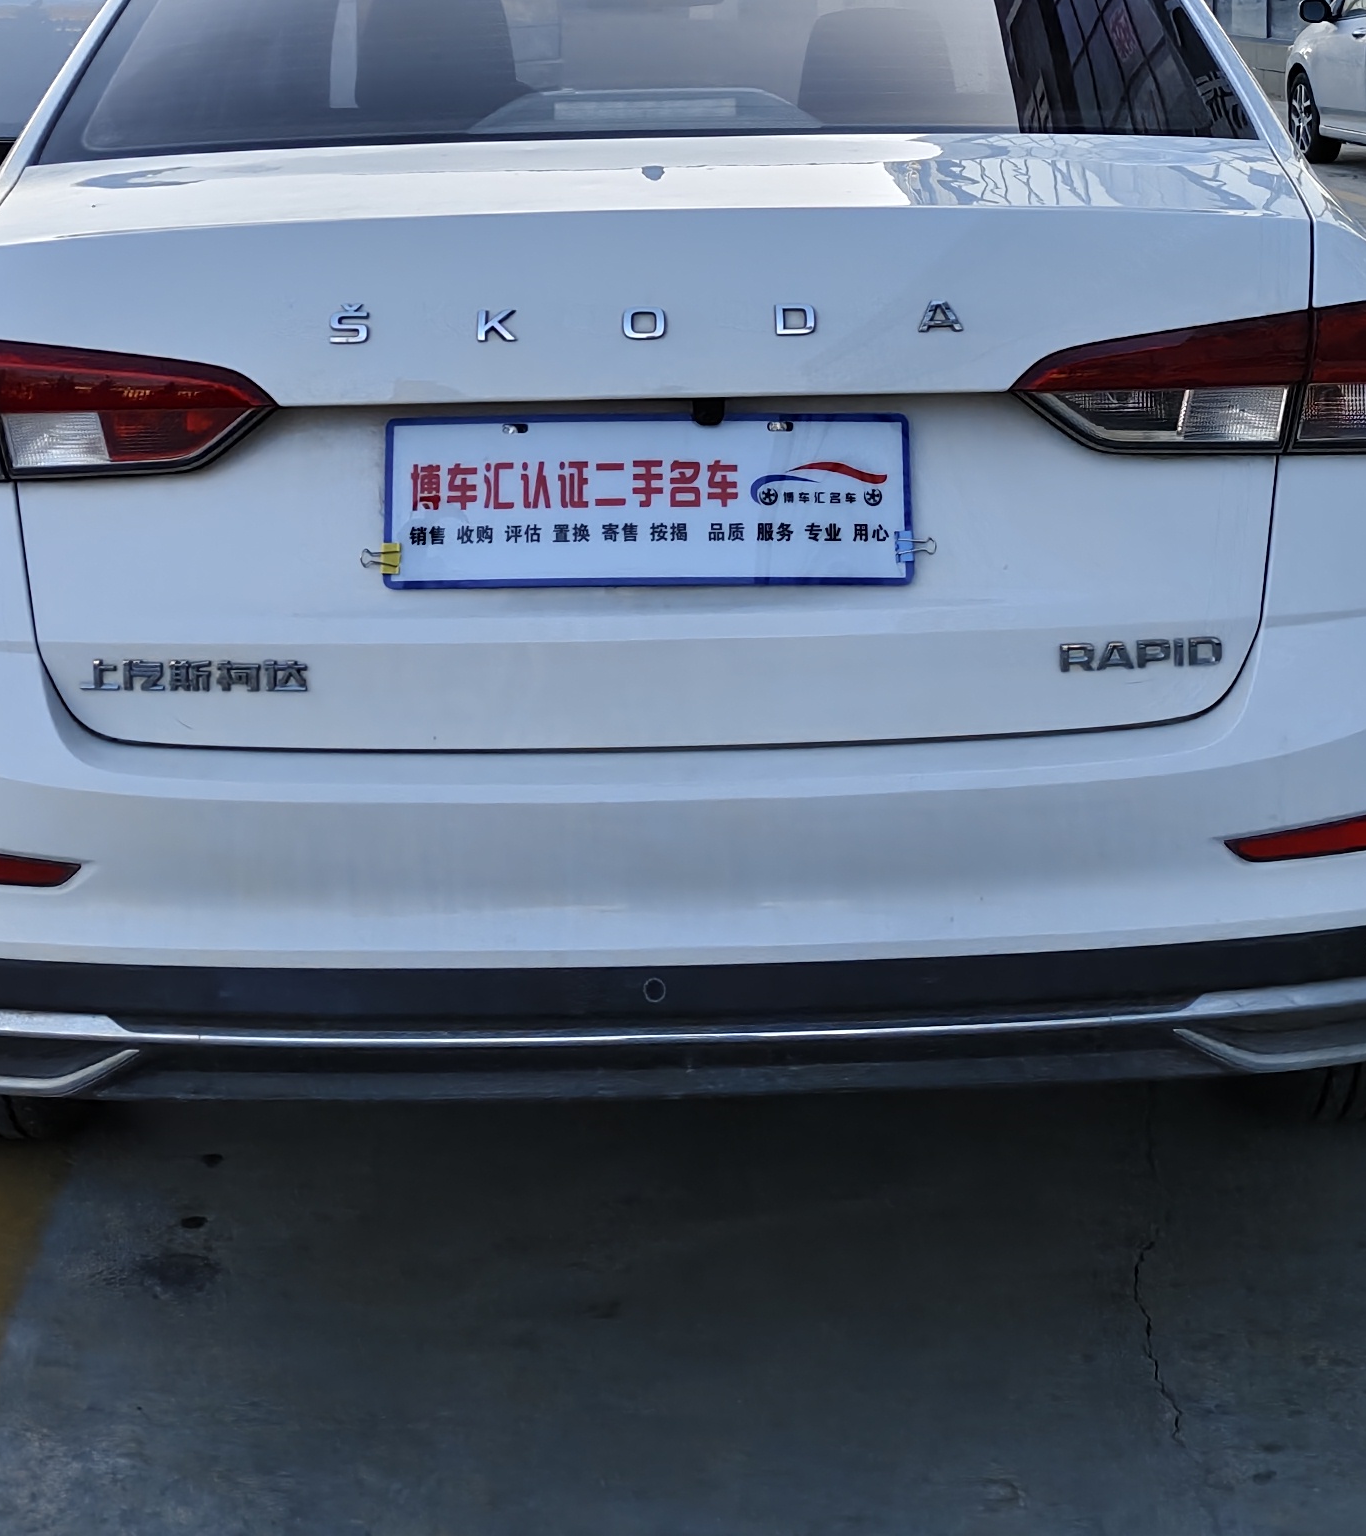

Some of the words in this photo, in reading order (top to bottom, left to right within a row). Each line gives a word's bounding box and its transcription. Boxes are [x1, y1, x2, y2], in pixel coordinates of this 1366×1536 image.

[328, 300, 965, 345] ŠKODA
[411, 460, 739, 512] 博车汇认证二手名车
[783, 490, 858, 505] 博车汇名车
[409, 526, 446, 546] 销售
[456, 525, 494, 545] 收购
[504, 524, 542, 544] 评估
[552, 524, 591, 543] 置换
[601, 523, 639, 543] 寄售
[650, 523, 688, 543] 按揭
[708, 523, 746, 542] 品质
[756, 523, 794, 542] 服务
[804, 523, 842, 542] 专业
[852, 523, 890, 542] 用心
[1059, 636, 1224, 673] RAPID
[78, 657, 310, 694] 上汽斯柯达
